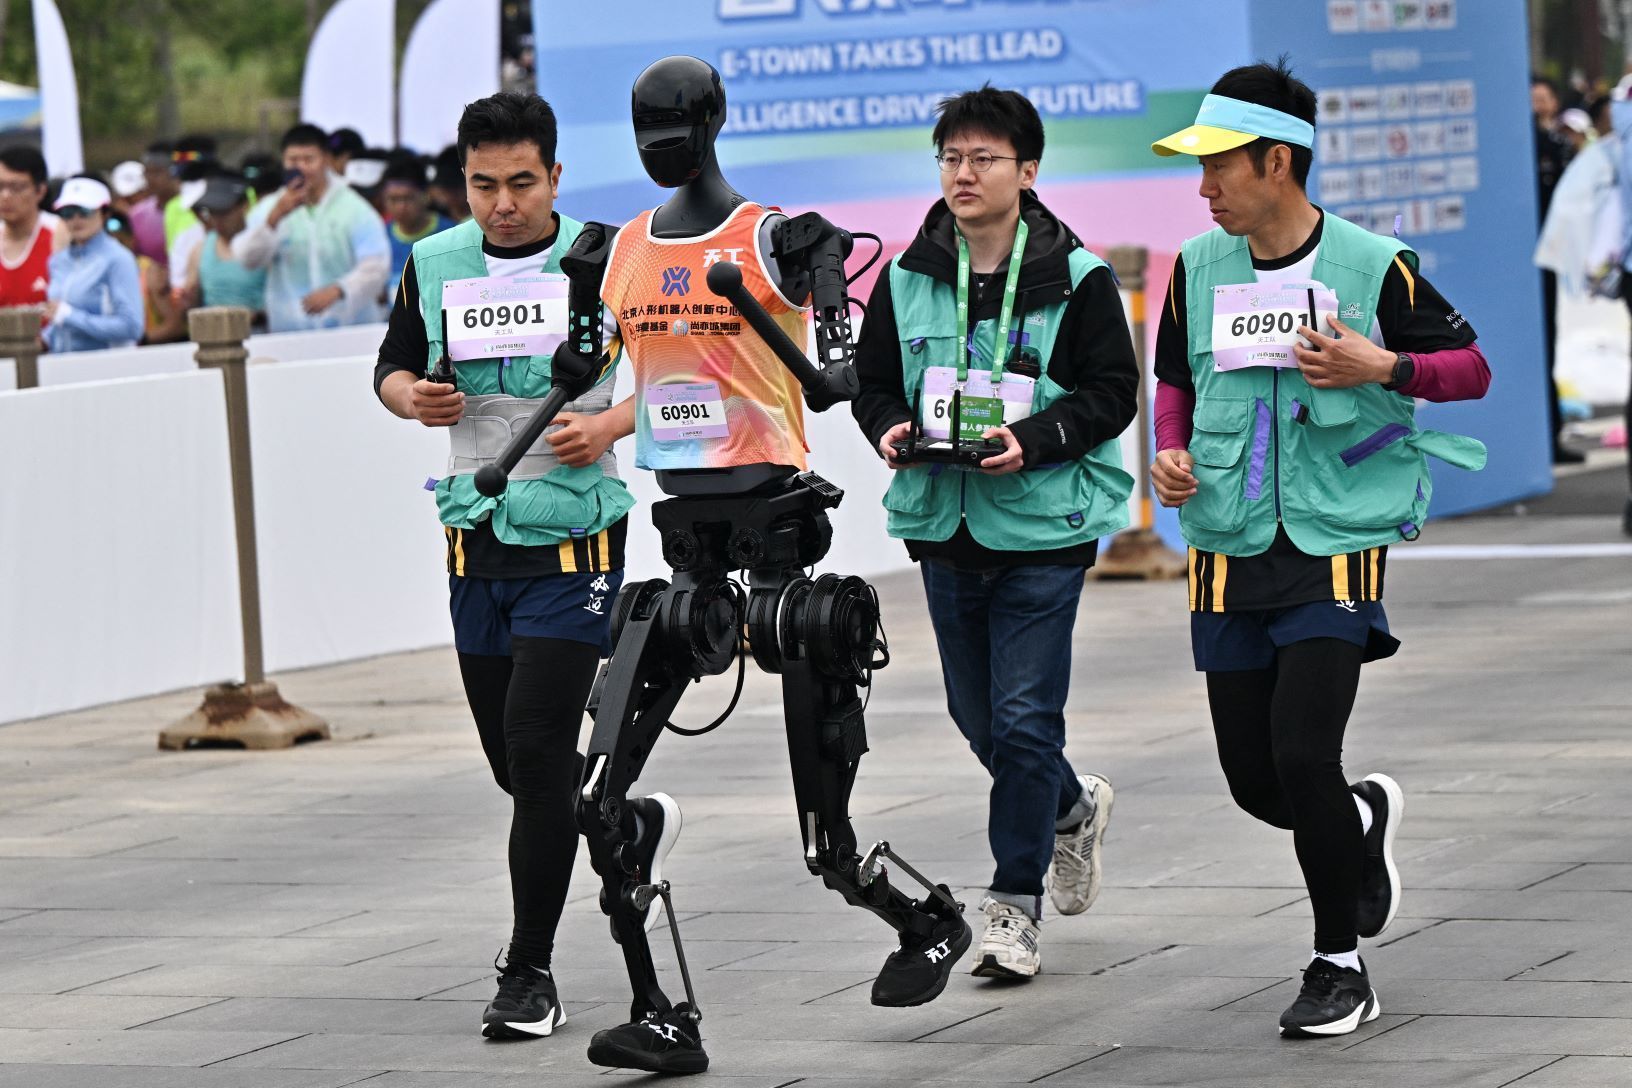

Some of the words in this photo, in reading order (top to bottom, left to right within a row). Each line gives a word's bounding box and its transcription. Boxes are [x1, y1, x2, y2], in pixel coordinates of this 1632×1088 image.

[721, 48, 833, 78] E-TOWN
[837, 37, 925, 69] TAKES
[928, 33, 981, 64] THE
[985, 29, 1063, 61] LEAD
[1027, 81, 1140, 113] FUTURE
[703, 248, 744, 268] 天工
[463, 303, 545, 329] 60901
[1231, 311, 1308, 337] 60901
[661, 403, 710, 421] 60901
